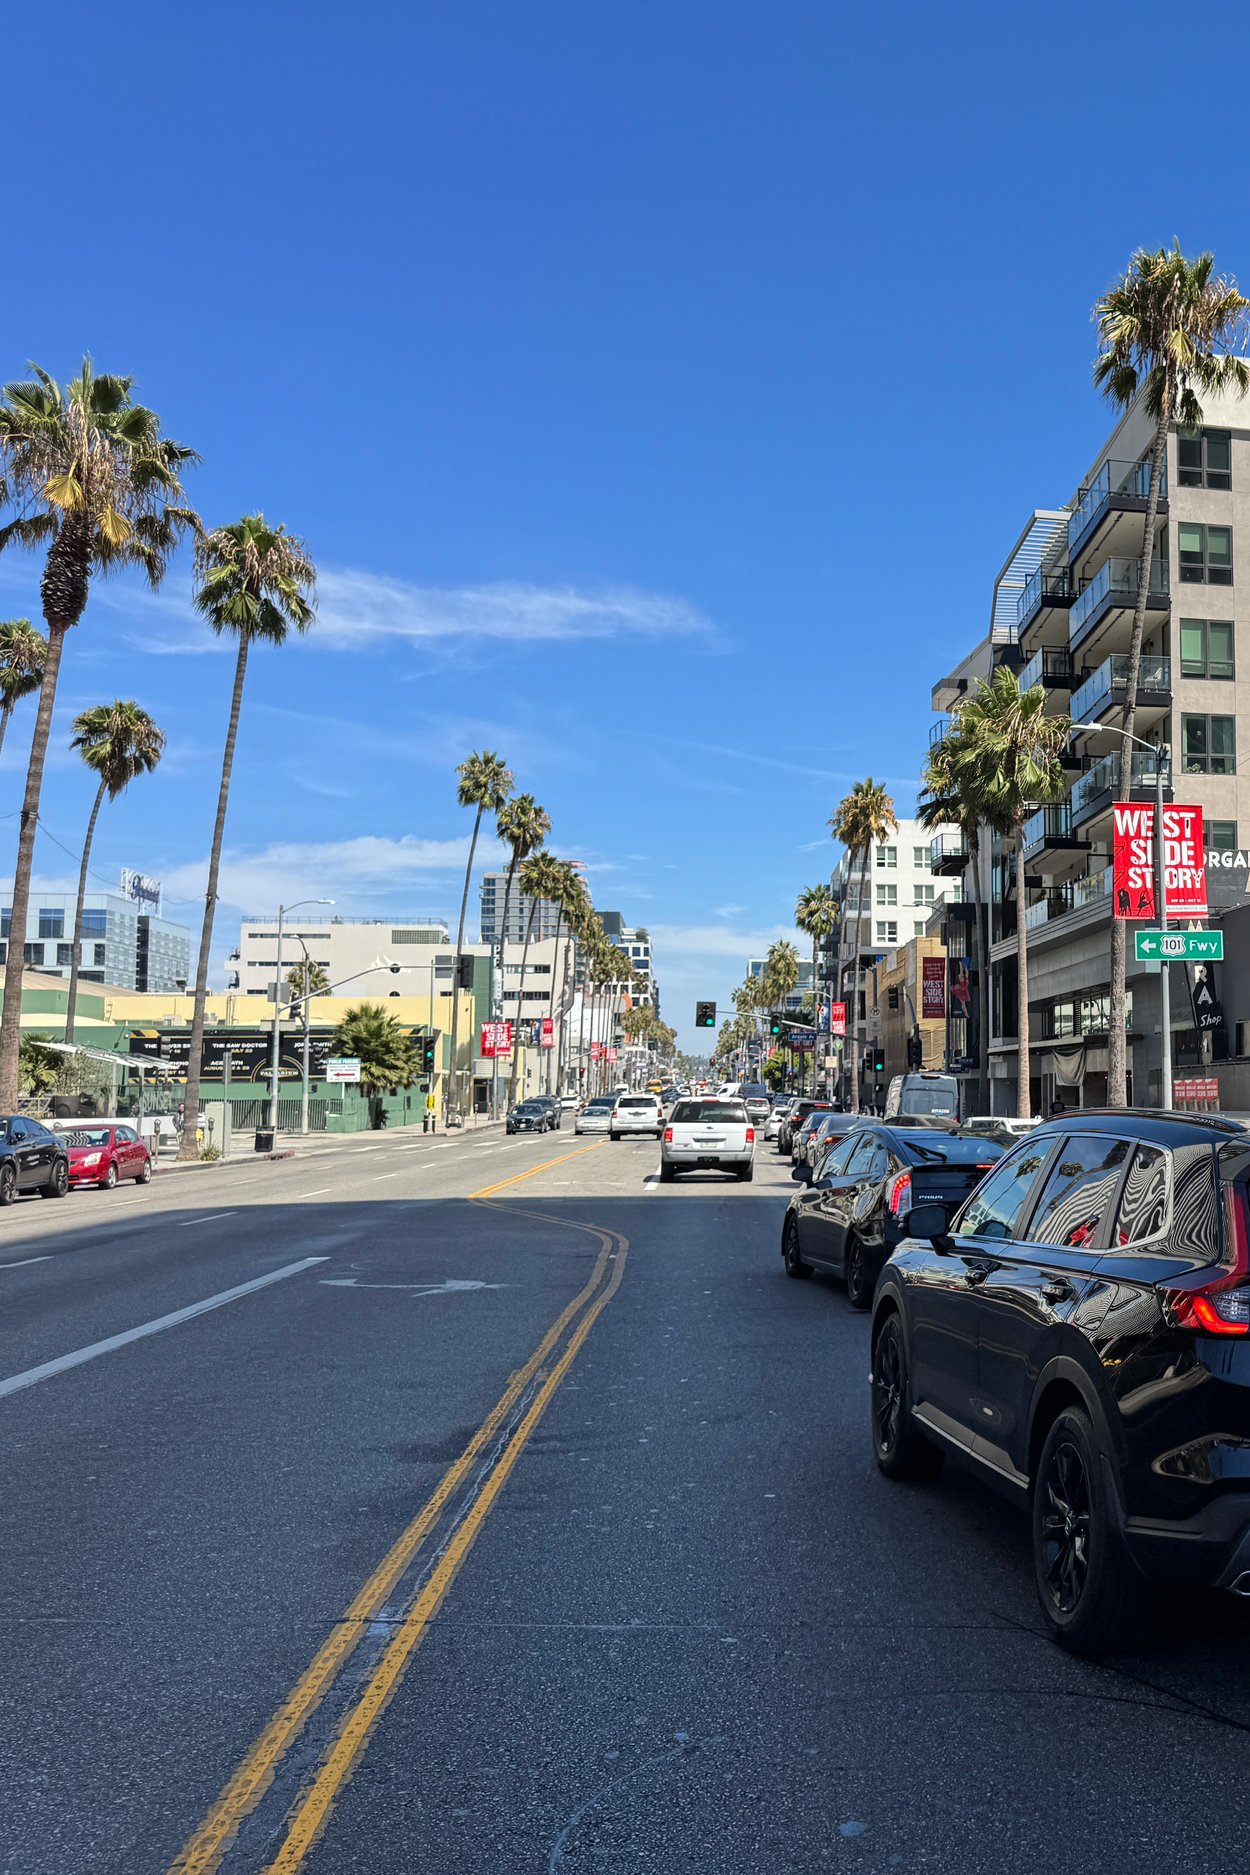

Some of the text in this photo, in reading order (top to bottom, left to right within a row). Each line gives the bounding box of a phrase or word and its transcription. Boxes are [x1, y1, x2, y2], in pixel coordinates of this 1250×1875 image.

[1114, 809, 1196, 838] WEST
[1130, 838, 1195, 867] SIDE
[1127, 868, 1204, 889] STORY
[1164, 939, 1218, 954] 101 Fwy
[923, 980, 945, 989] WEST
[925, 988, 943, 997] SIDE
[1200, 1013, 1222, 1027] Shop
[481, 1023, 510, 1033] WEST
[486, 1031, 509, 1042] SIDE
